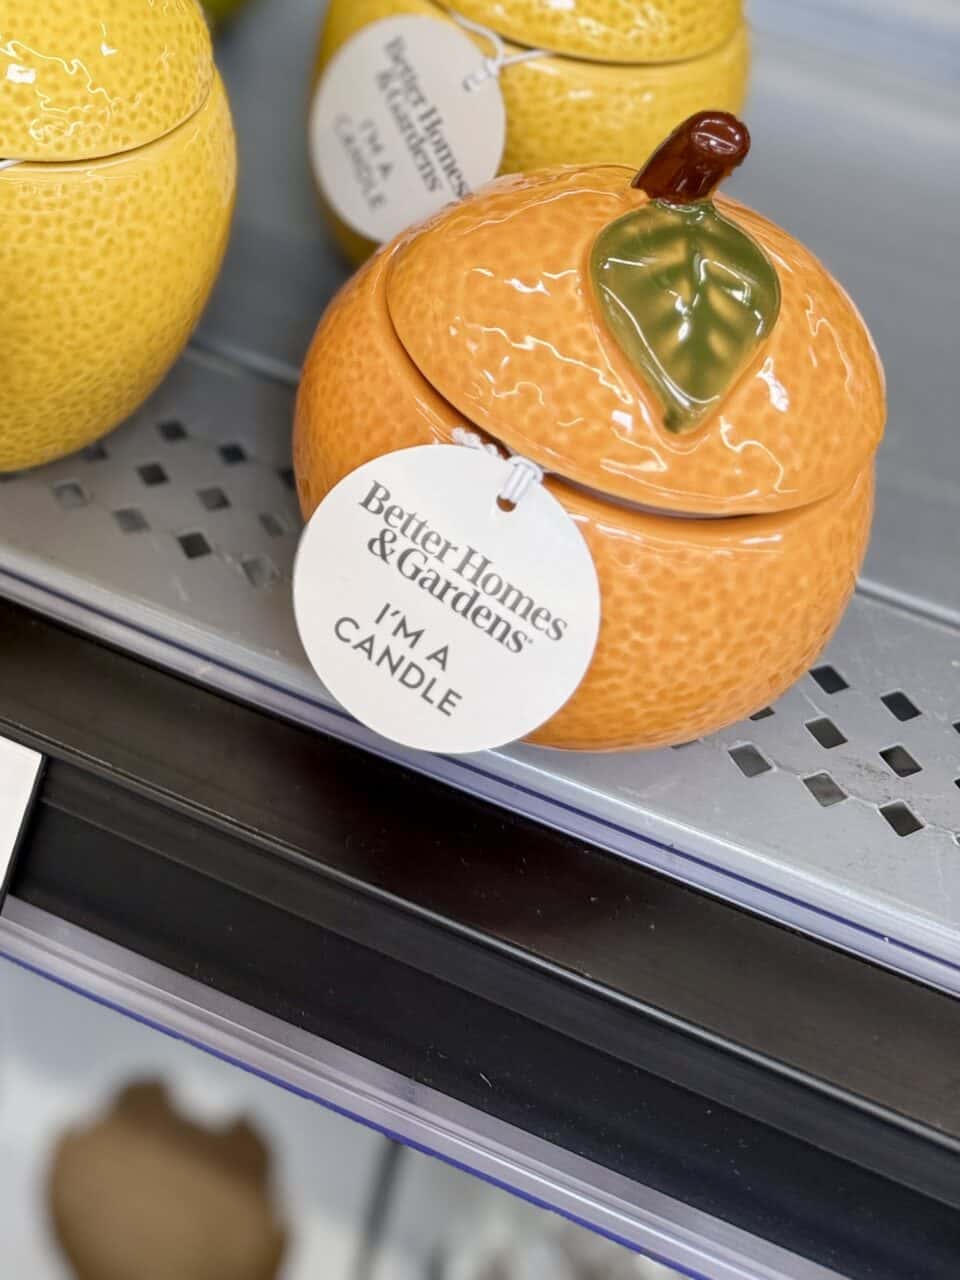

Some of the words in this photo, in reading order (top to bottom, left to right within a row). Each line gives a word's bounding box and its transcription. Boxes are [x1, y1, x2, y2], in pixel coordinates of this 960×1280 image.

[358, 480, 459, 565] Better
[453, 545, 568, 641] Homes
[334, 617, 463, 717] CANDLE
[374, 602, 425, 649] I'M
[426, 645, 449, 671] A
